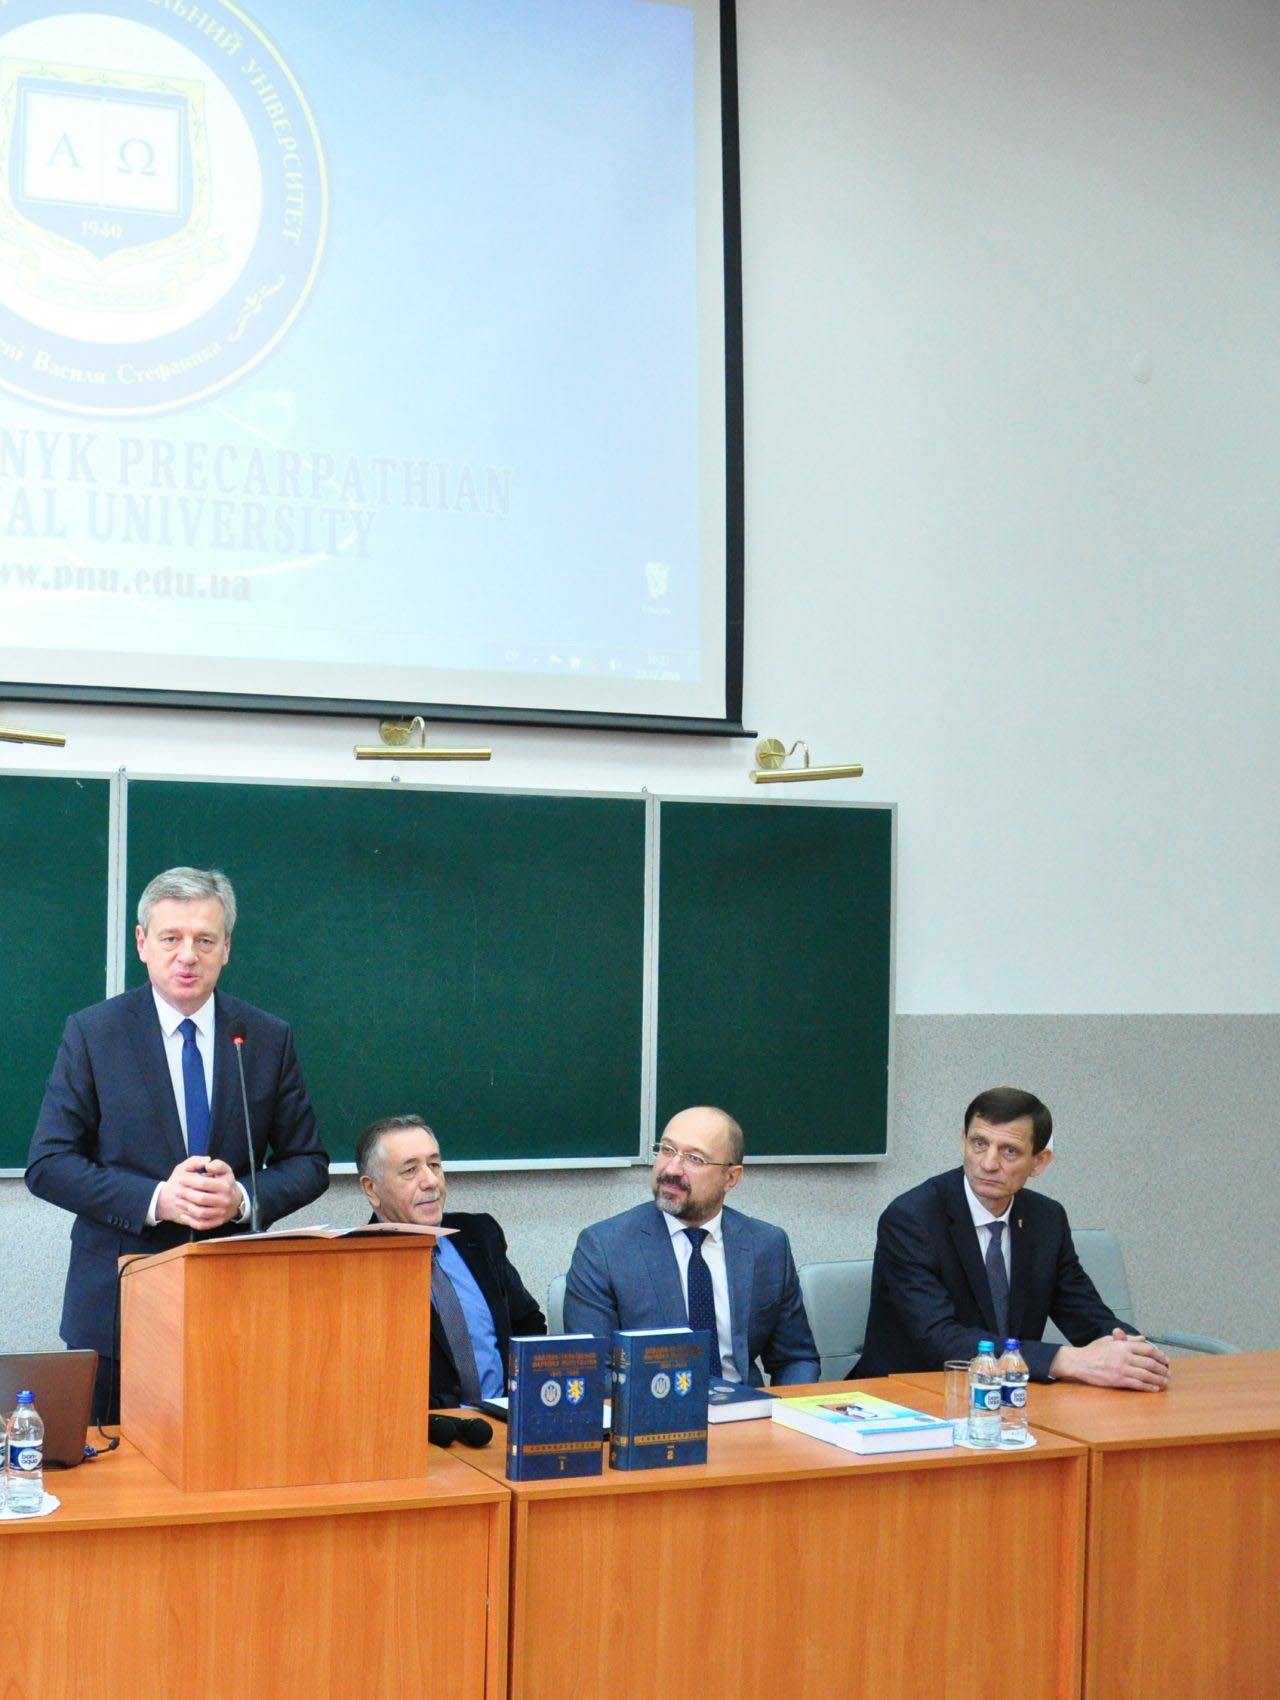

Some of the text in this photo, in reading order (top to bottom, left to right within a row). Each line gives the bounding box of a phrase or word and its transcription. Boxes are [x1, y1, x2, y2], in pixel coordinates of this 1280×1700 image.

[116, 137, 157, 176] Ω
[241, 56, 305, 245] УНІВЕРСИТЕТ
[81, 220, 124, 240] 1940
[119, 436, 512, 515] PRECARPATHIAN
[87, 490, 376, 559] UNIVERSITY
